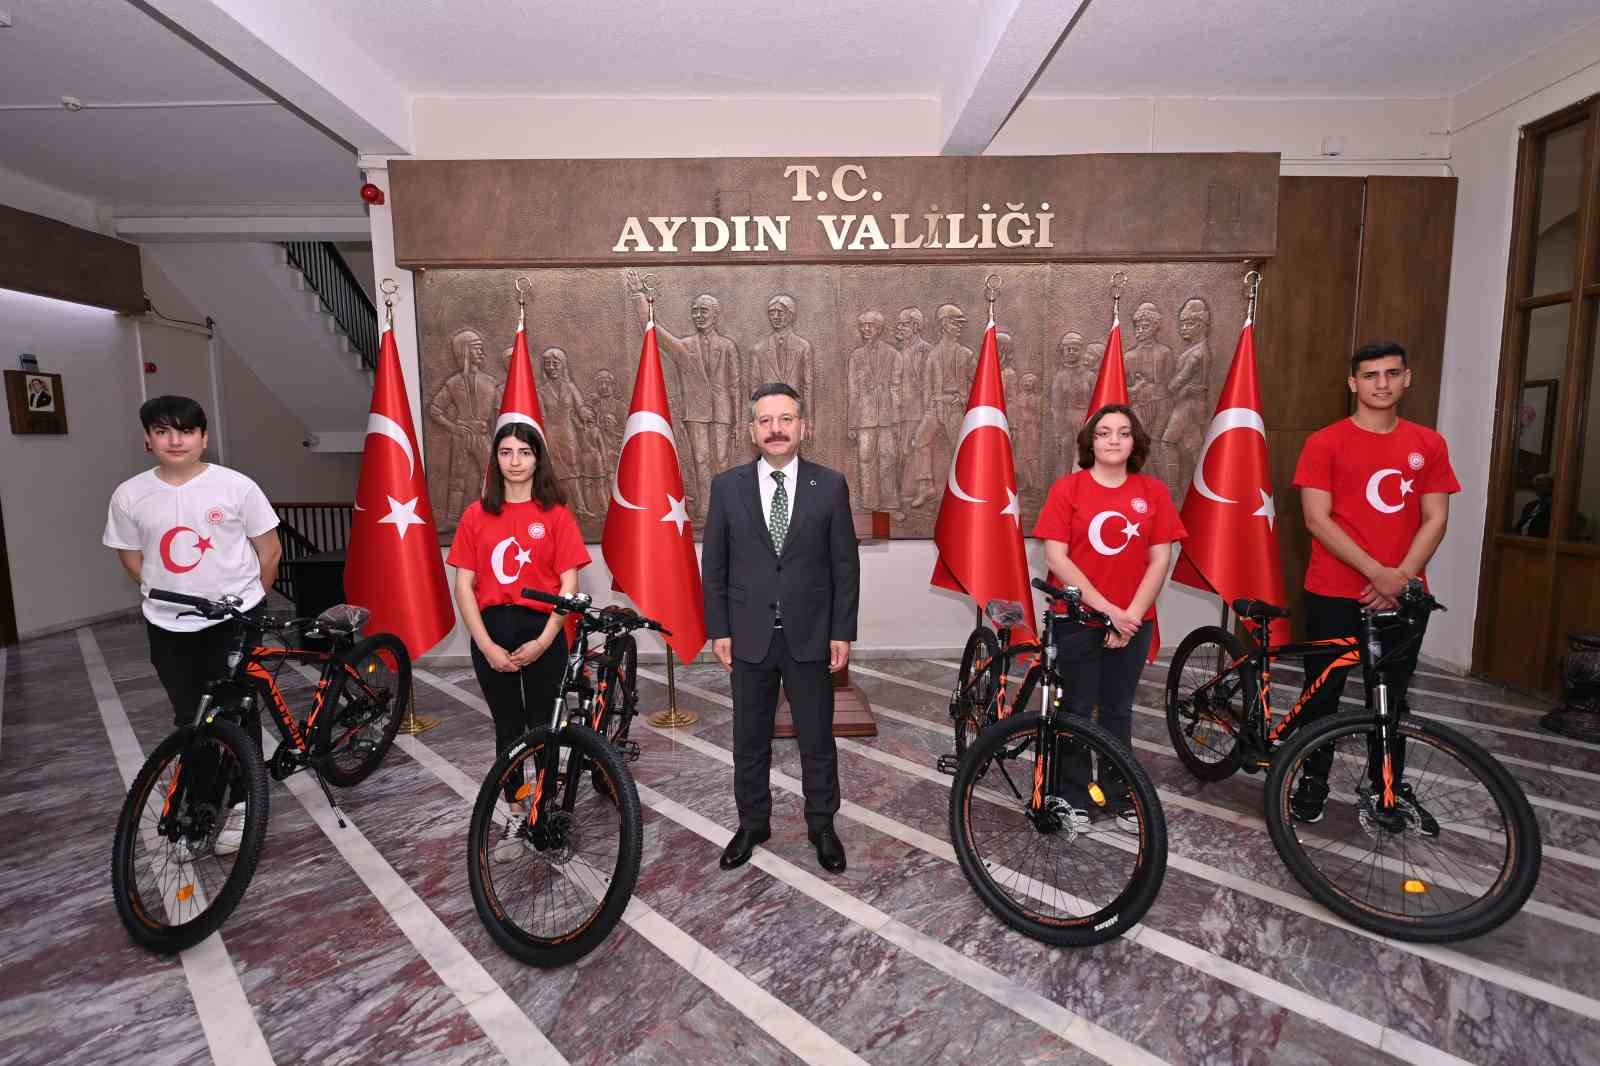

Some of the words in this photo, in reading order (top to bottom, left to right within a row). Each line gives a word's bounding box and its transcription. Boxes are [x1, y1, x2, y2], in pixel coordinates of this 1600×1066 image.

[783, 164, 883, 202] T.C.
[612, 214, 791, 252] AYDIN
[816, 202, 1055, 250] VALİLİĞİ
